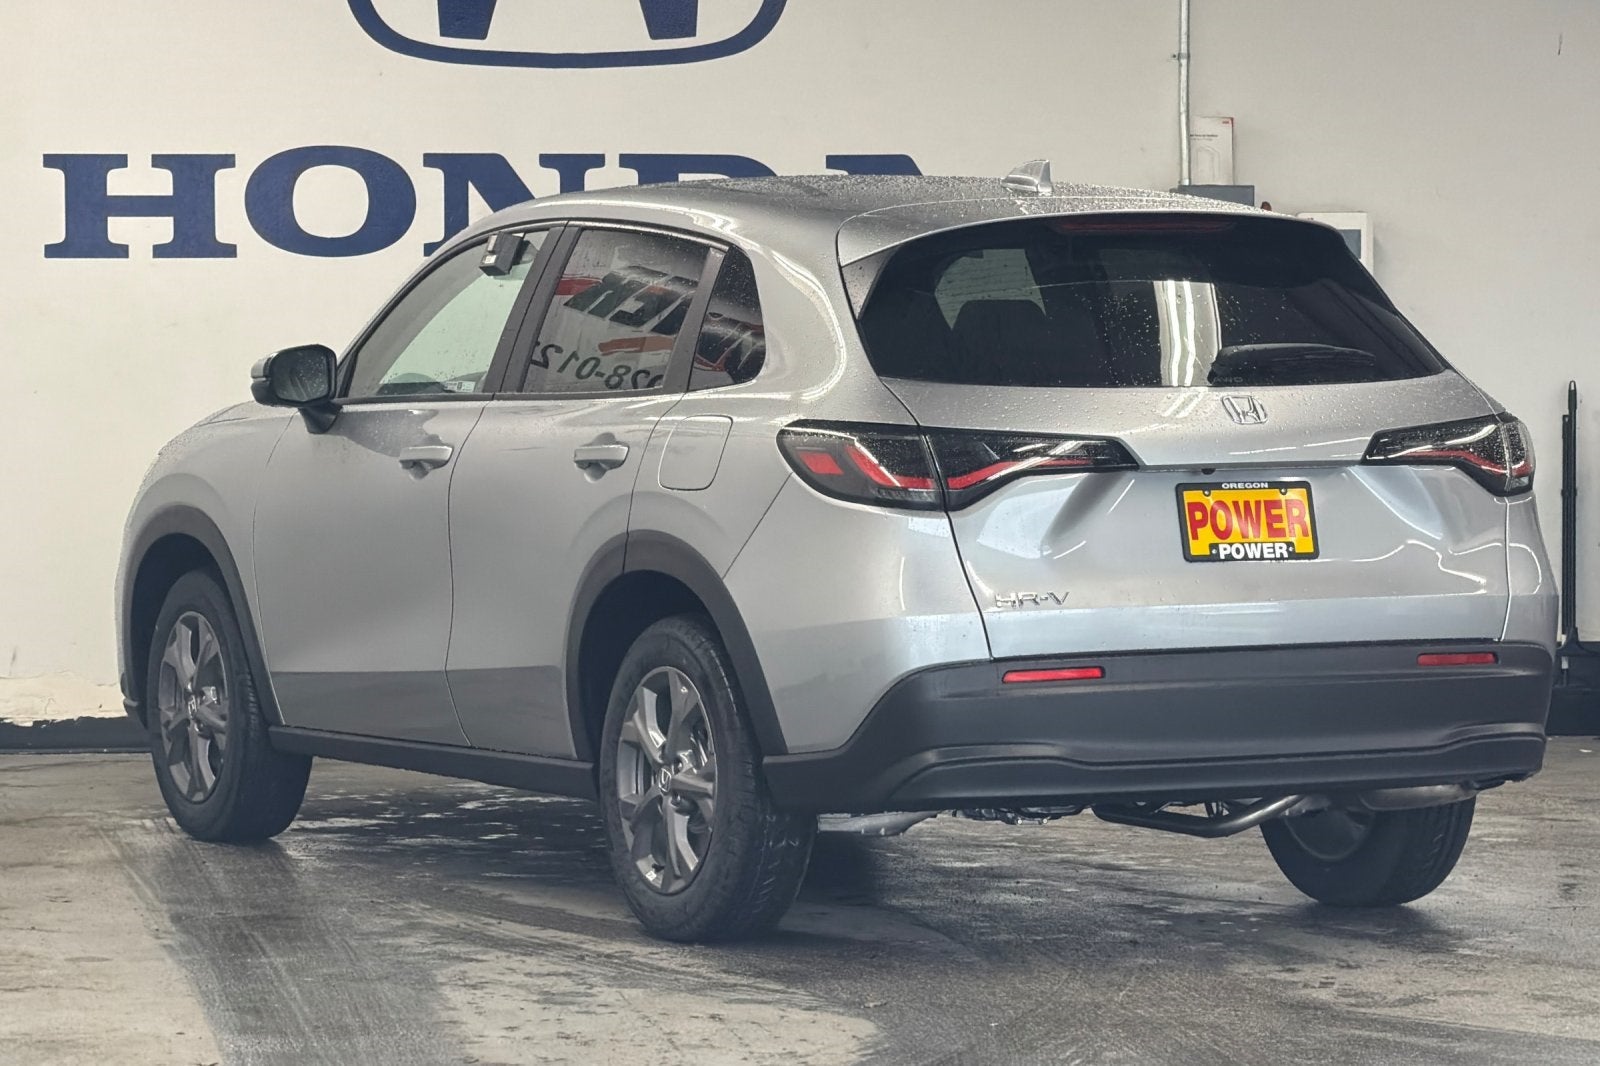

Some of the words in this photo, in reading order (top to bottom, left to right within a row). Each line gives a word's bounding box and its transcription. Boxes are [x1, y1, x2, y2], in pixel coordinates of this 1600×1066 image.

[1187, 499, 1309, 541] POWER
[1218, 542, 1289, 559] POWER
[994, 591, 1070, 608] HR-V
